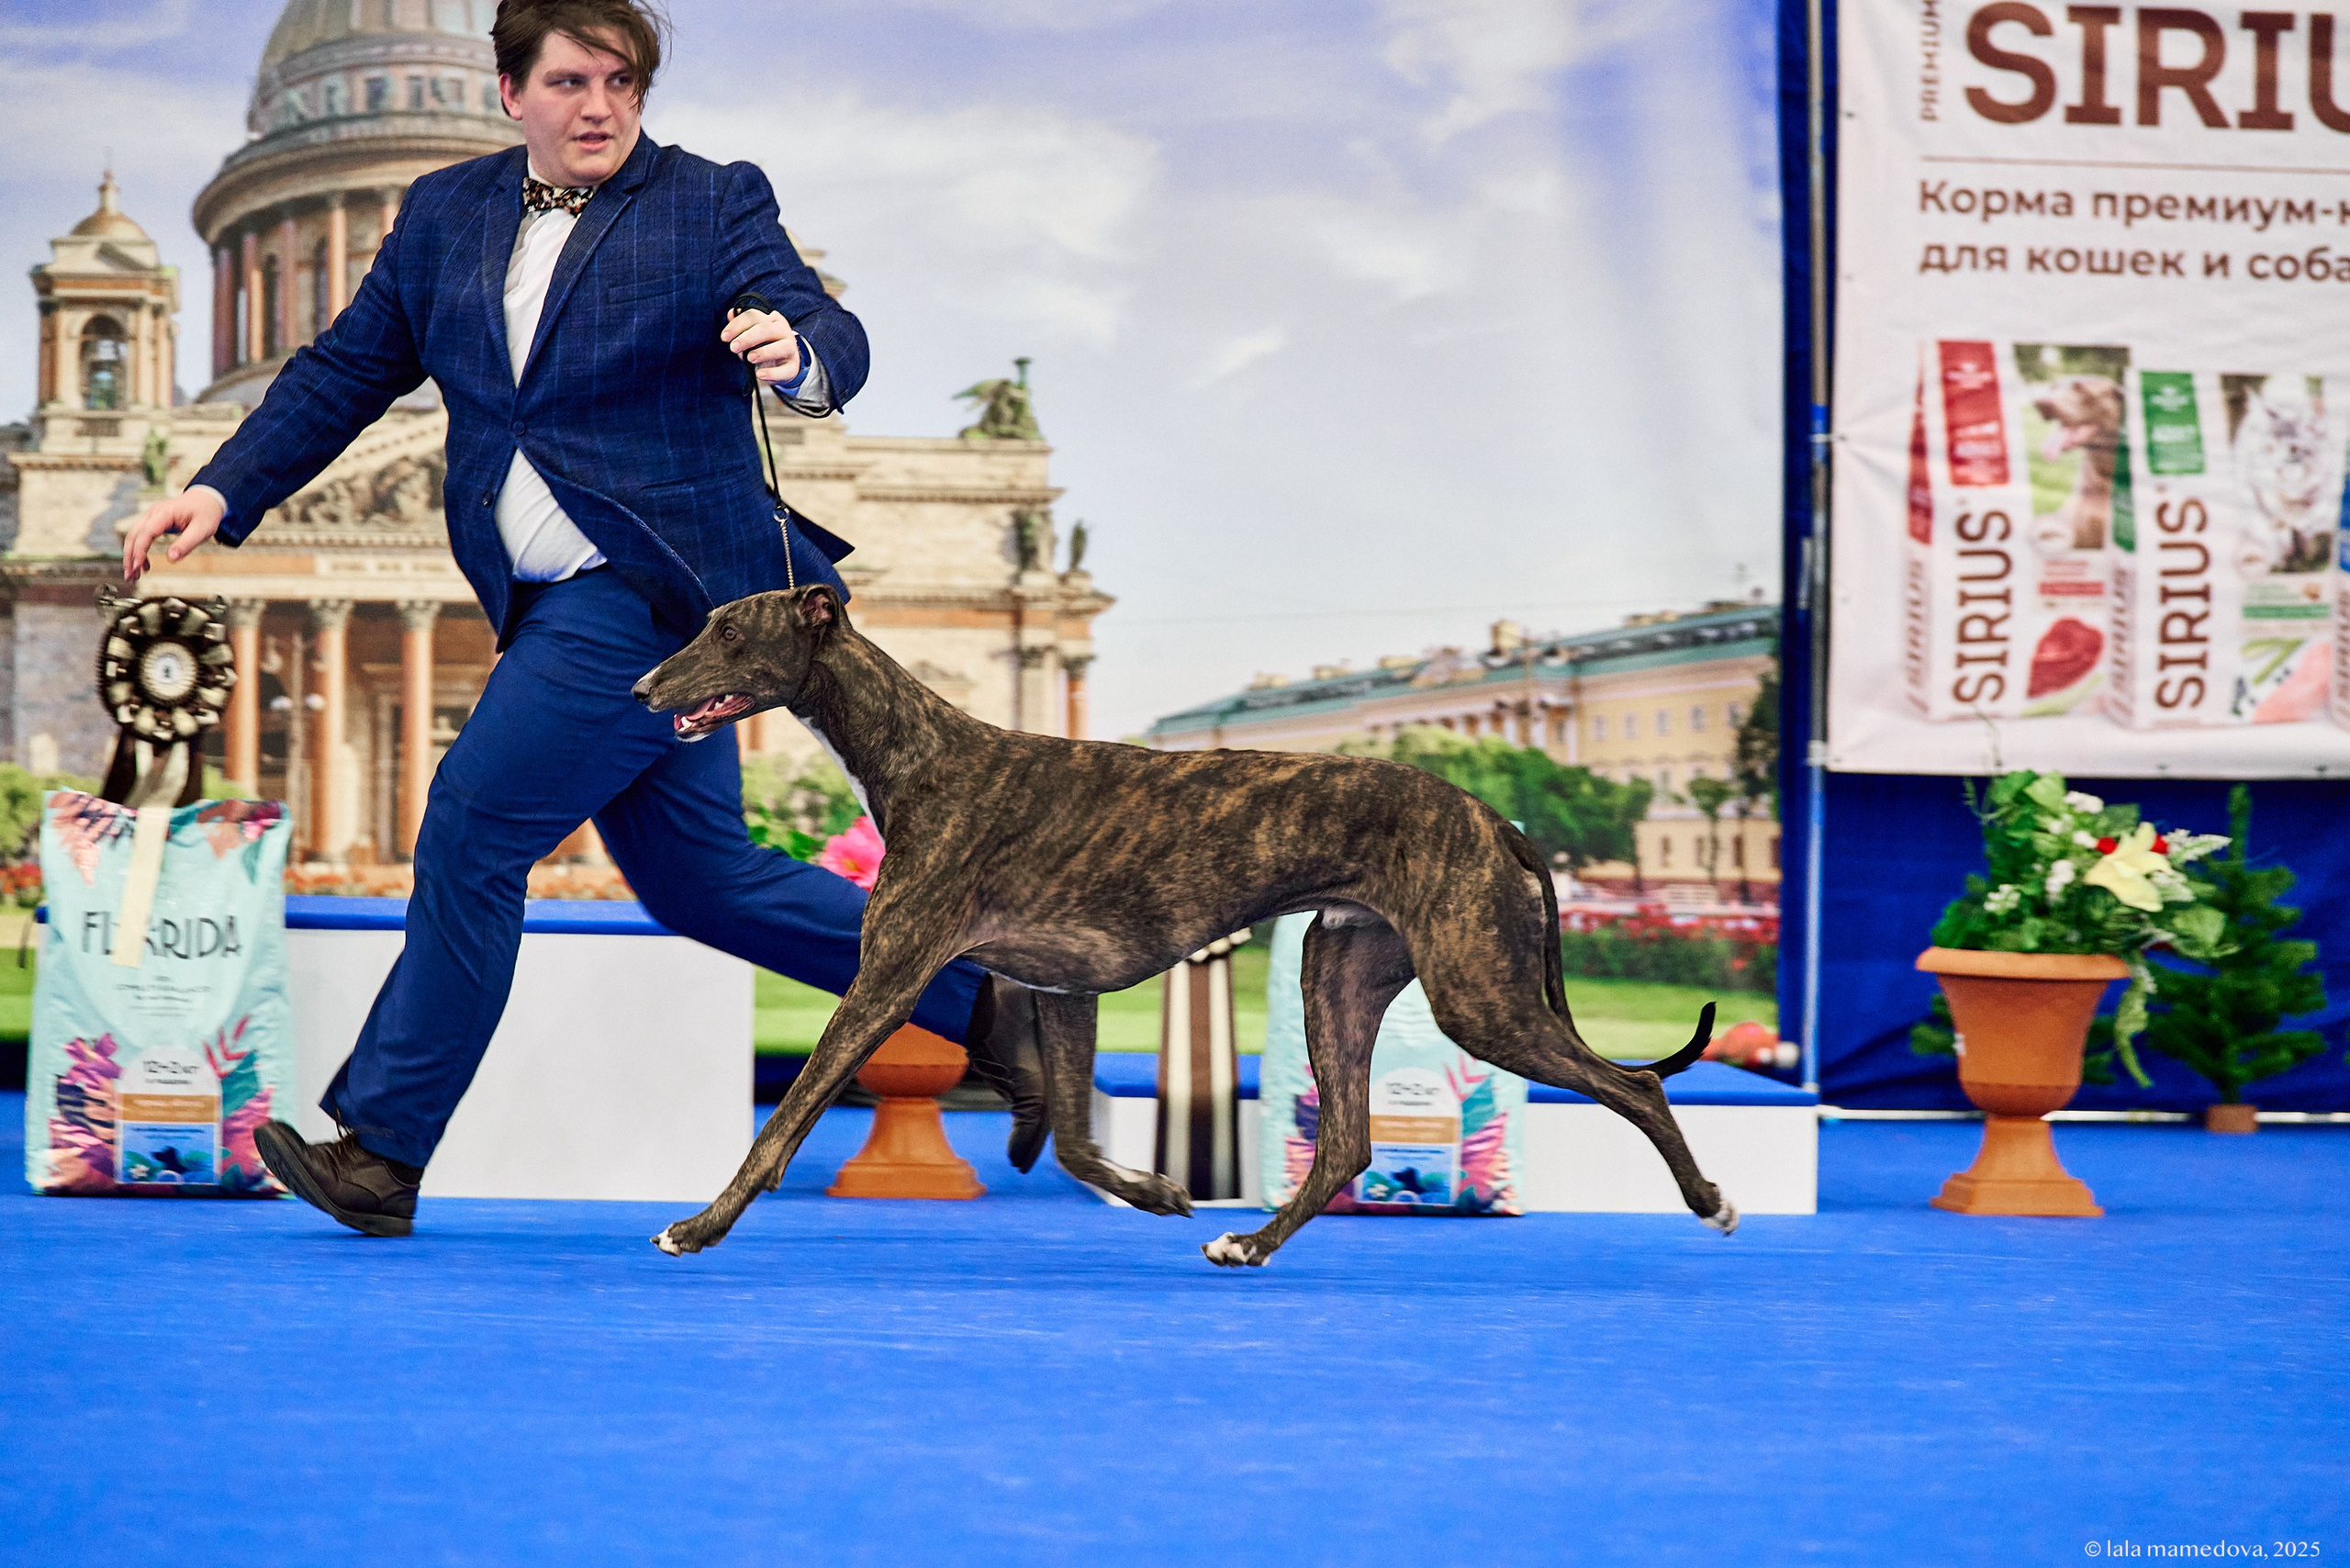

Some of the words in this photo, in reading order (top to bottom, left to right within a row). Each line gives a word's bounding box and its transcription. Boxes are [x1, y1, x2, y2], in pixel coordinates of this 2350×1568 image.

[1919, 182, 2075, 223] Корма
[1919, 244, 2009, 274] для
[2027, 248, 2187, 278] кошек
[2203, 252, 2231, 279] и
[1953, 510, 2014, 704] SIRIUS
[2155, 498, 2212, 711] SIRIUS
[83, 910, 242, 959] FLRIDA
